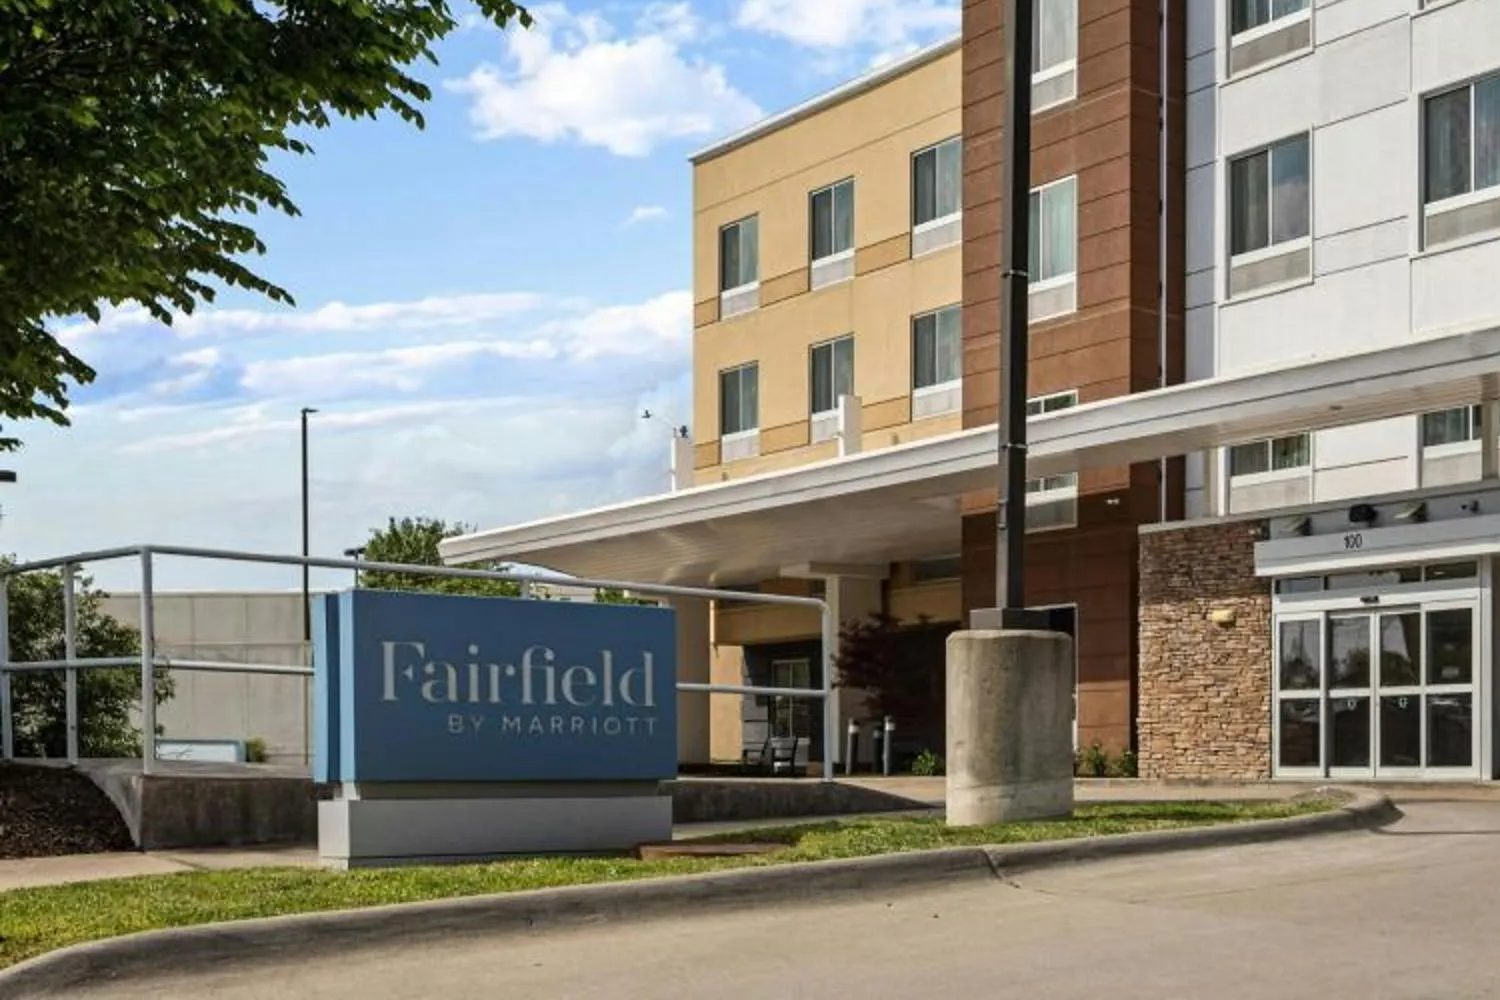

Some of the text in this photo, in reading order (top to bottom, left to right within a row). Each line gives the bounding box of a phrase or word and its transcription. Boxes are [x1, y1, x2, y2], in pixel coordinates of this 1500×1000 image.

[381, 640, 656, 708] Fairfield
[447, 713, 658, 736] BY MARRIOTT
